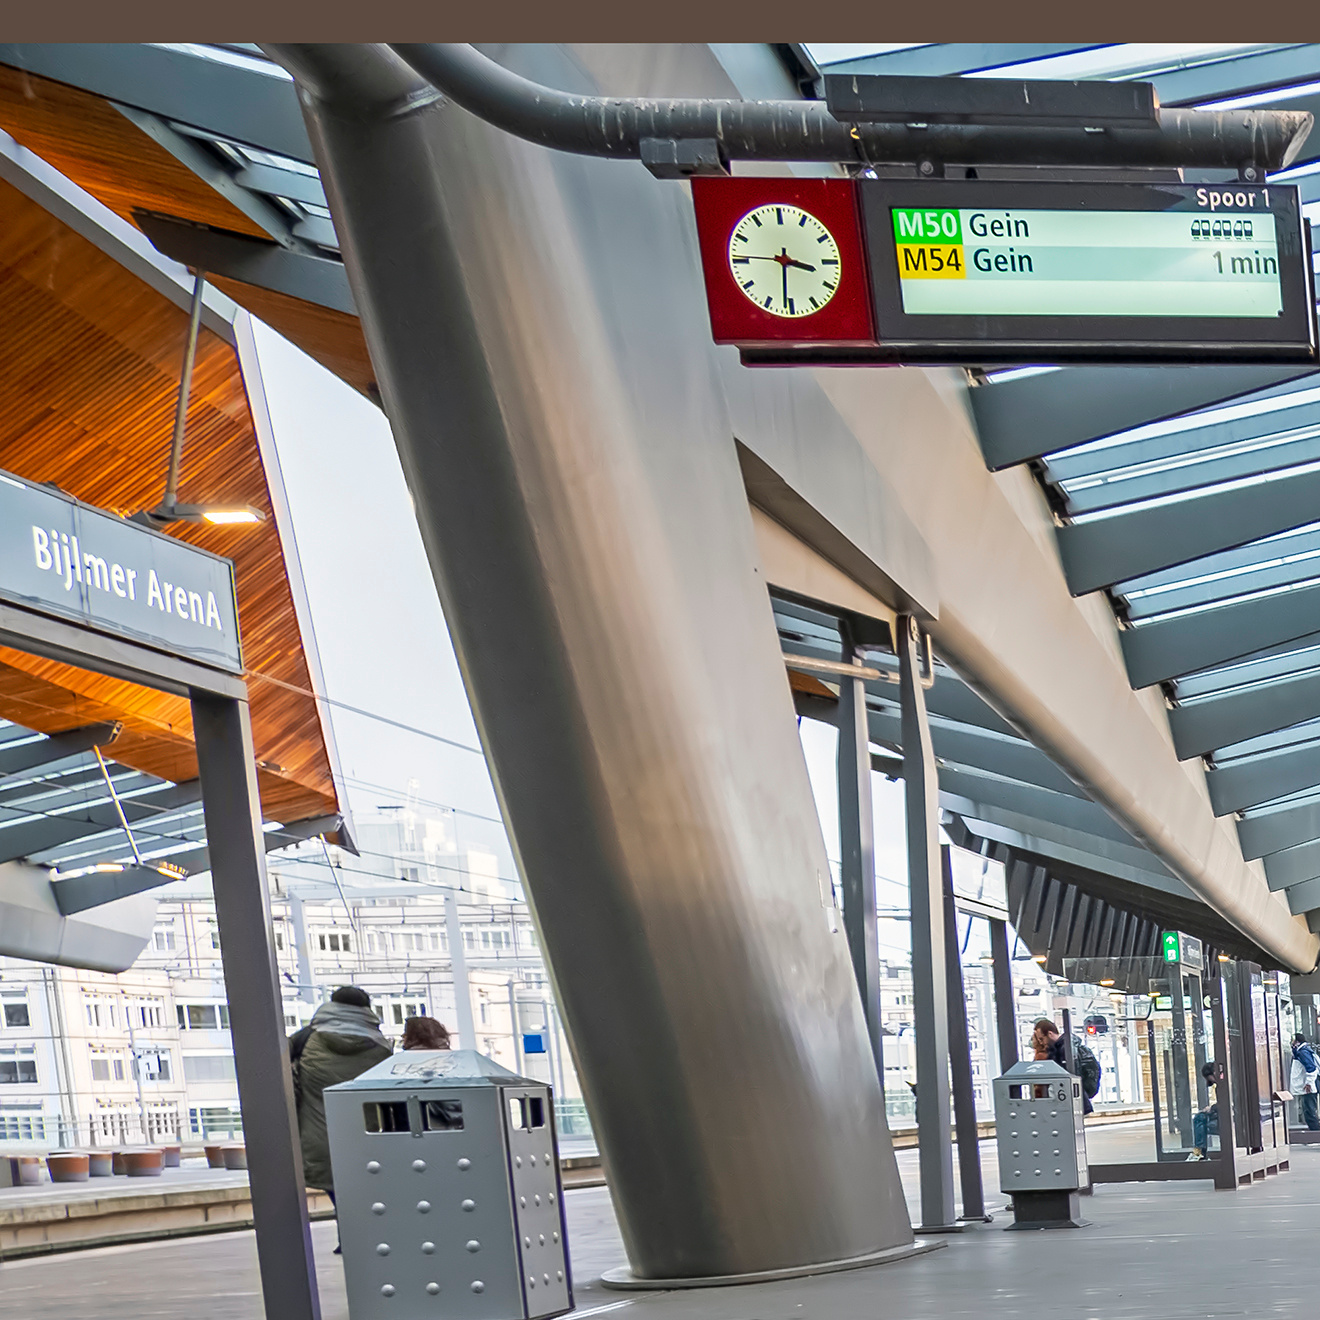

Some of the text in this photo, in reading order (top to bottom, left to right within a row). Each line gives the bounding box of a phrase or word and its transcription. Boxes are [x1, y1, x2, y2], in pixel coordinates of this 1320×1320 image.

[1196, 187, 1270, 212] Spoor 1
[898, 211, 1030, 238] M50 Gein
[902, 247, 1277, 275] M54 Gein 1 min
[32, 525, 223, 632] Bijlmer ArenA
[1057, 1089, 1067, 1101] 6
